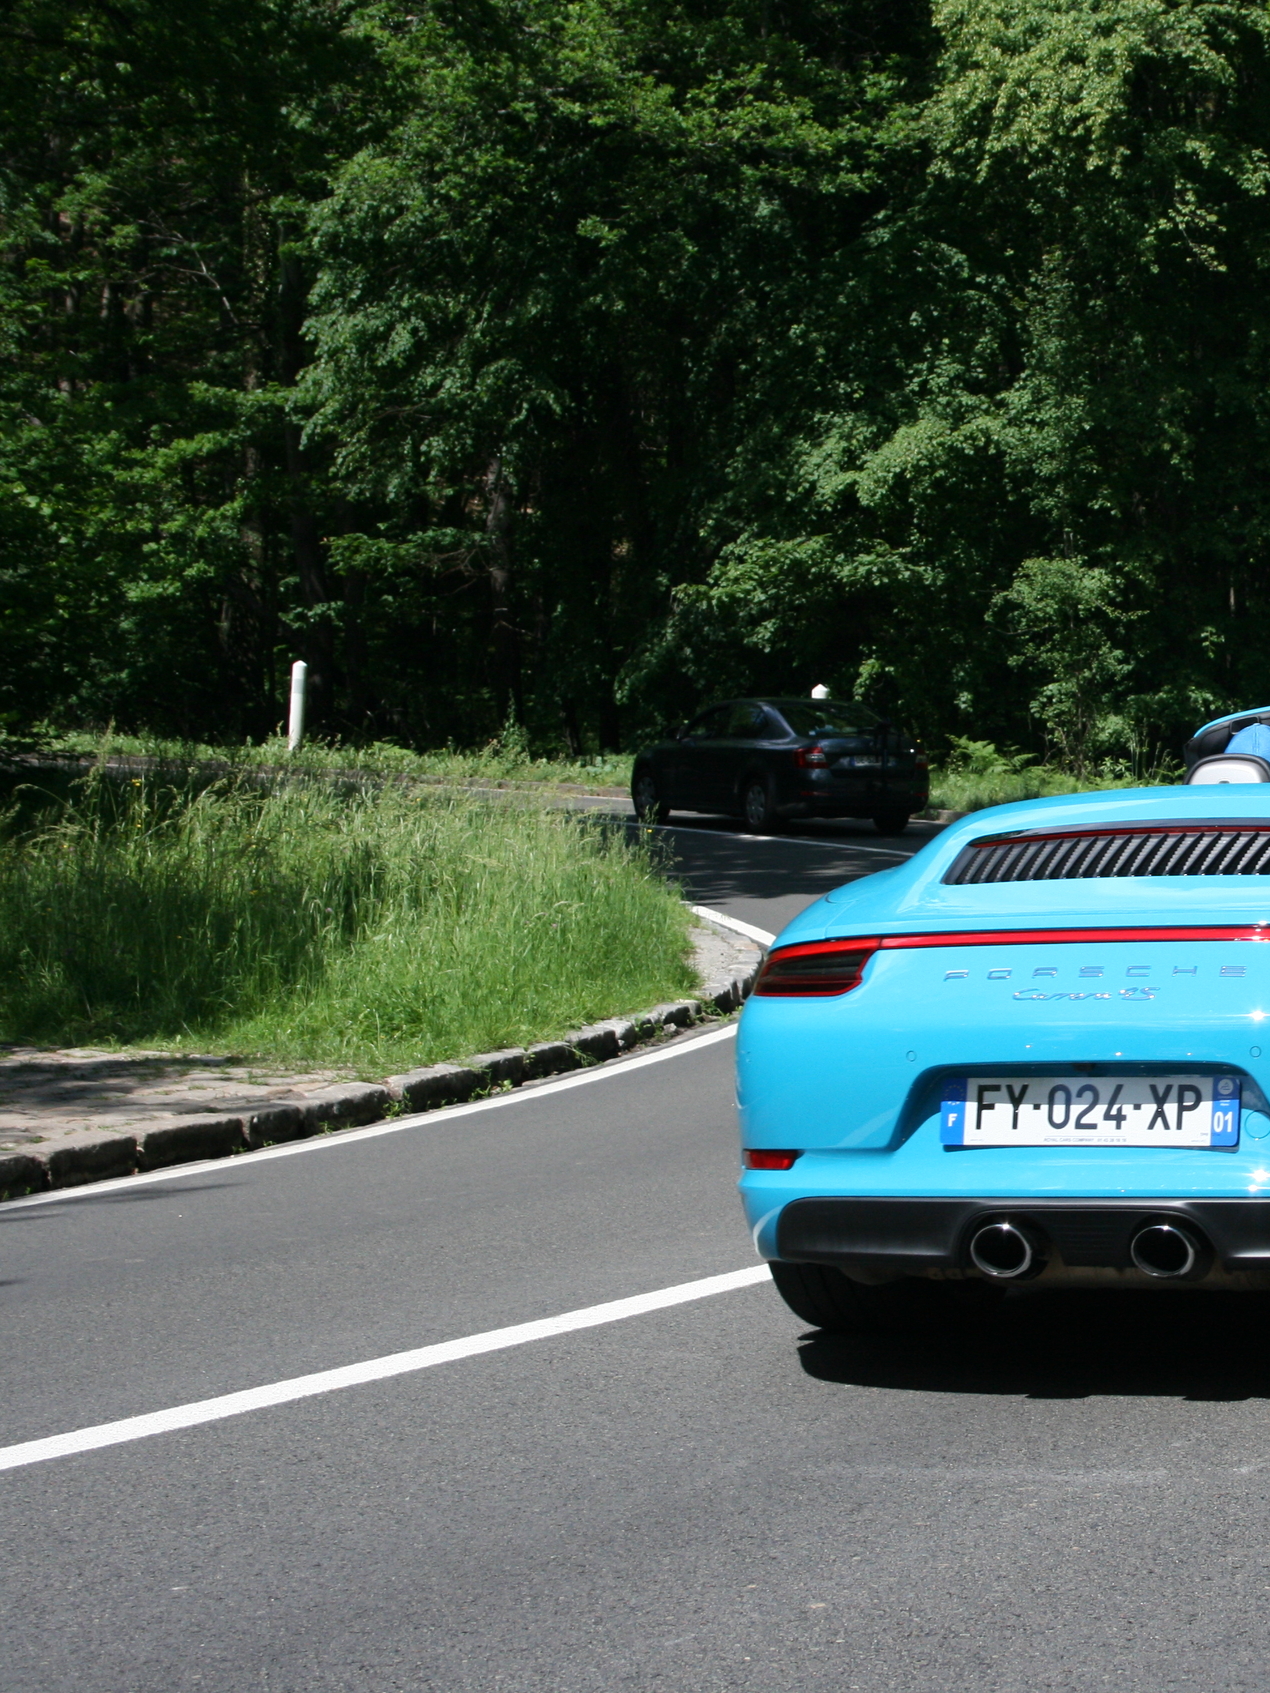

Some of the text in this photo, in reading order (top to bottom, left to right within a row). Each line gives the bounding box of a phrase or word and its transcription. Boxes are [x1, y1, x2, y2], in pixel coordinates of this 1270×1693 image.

[943, 965, 1247, 981] PORSCHE
[975, 1083, 1203, 1131] FY-024-XP
[947, 1113, 958, 1127] F
[1213, 1111, 1233, 1133] 01
